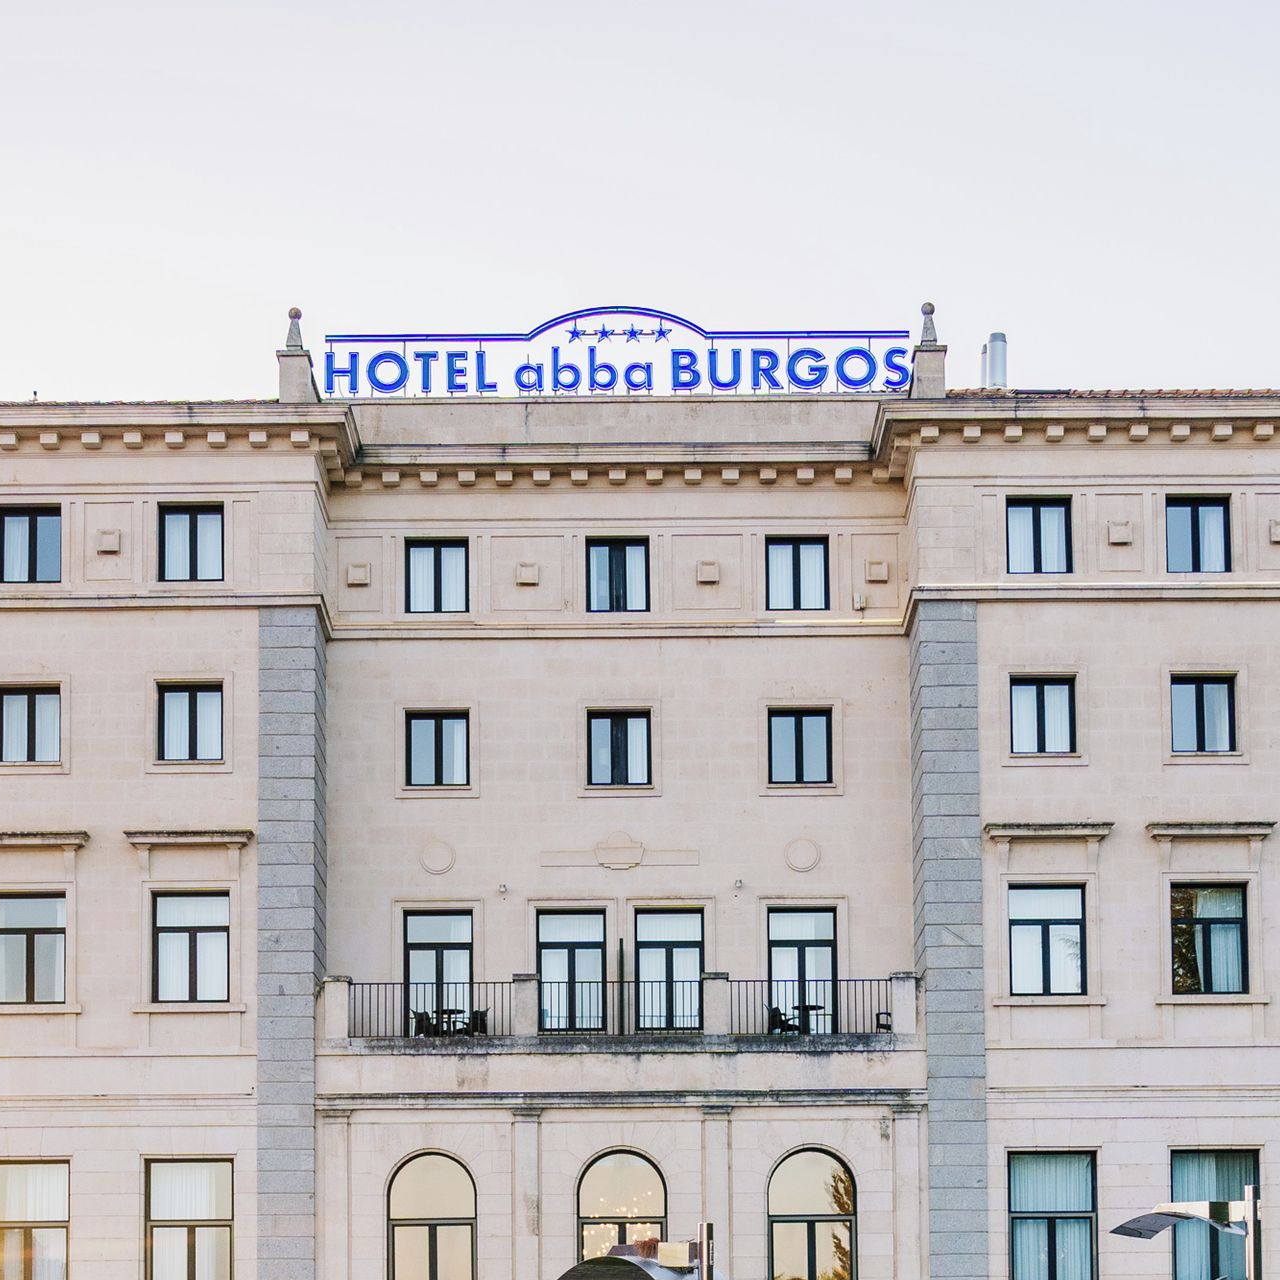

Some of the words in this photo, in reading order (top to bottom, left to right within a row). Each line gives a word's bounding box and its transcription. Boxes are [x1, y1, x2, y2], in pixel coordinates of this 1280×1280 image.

[324, 350, 498, 394] HOTEL
[514, 346, 654, 392] abba
[671, 346, 913, 390] BURGOS
